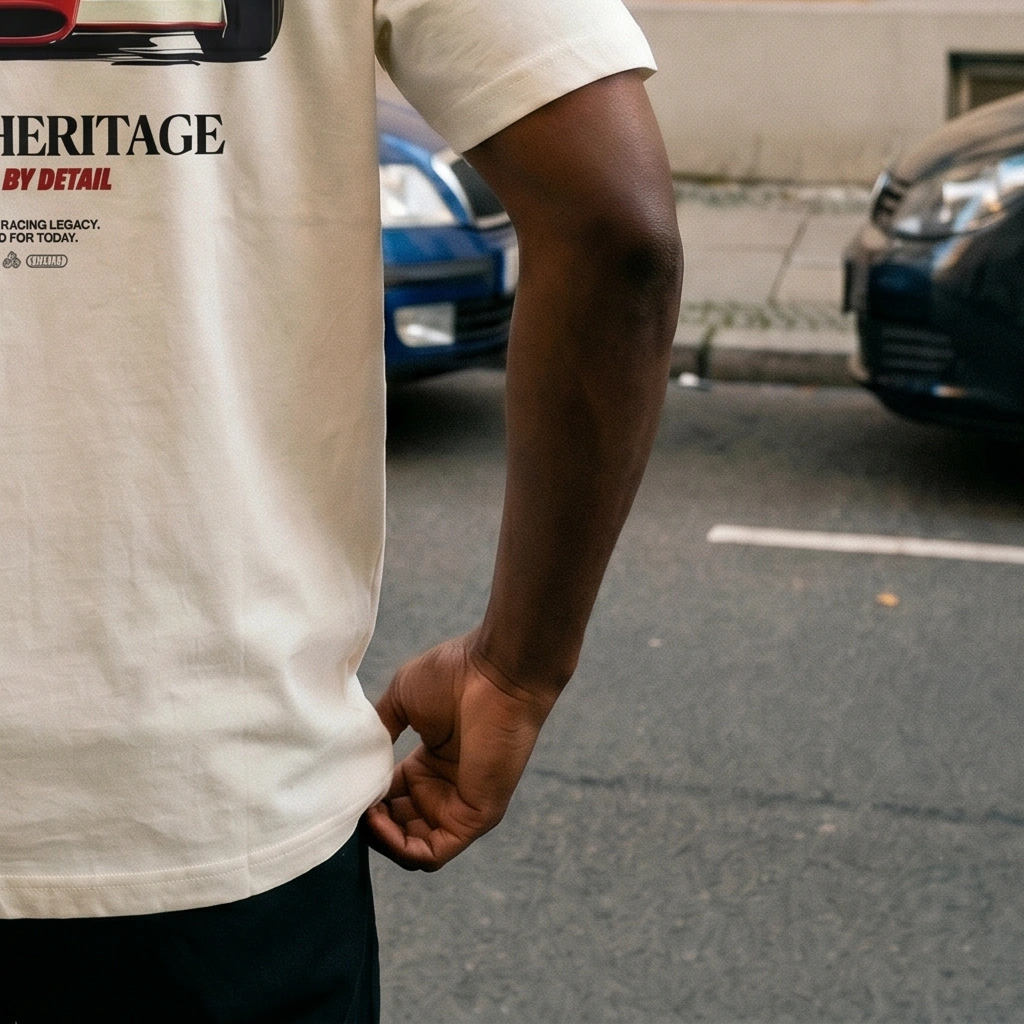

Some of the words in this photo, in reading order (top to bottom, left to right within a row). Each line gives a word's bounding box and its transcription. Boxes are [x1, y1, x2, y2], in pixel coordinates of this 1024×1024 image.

[2, 167, 36, 191] BY
[37, 167, 112, 191] DETAIL
[0, 219, 48, 230] RACING
[49, 219, 101, 230] LEGACY.
[9, 232, 35, 243] FOR
[36, 232, 79, 243] TODAY.
